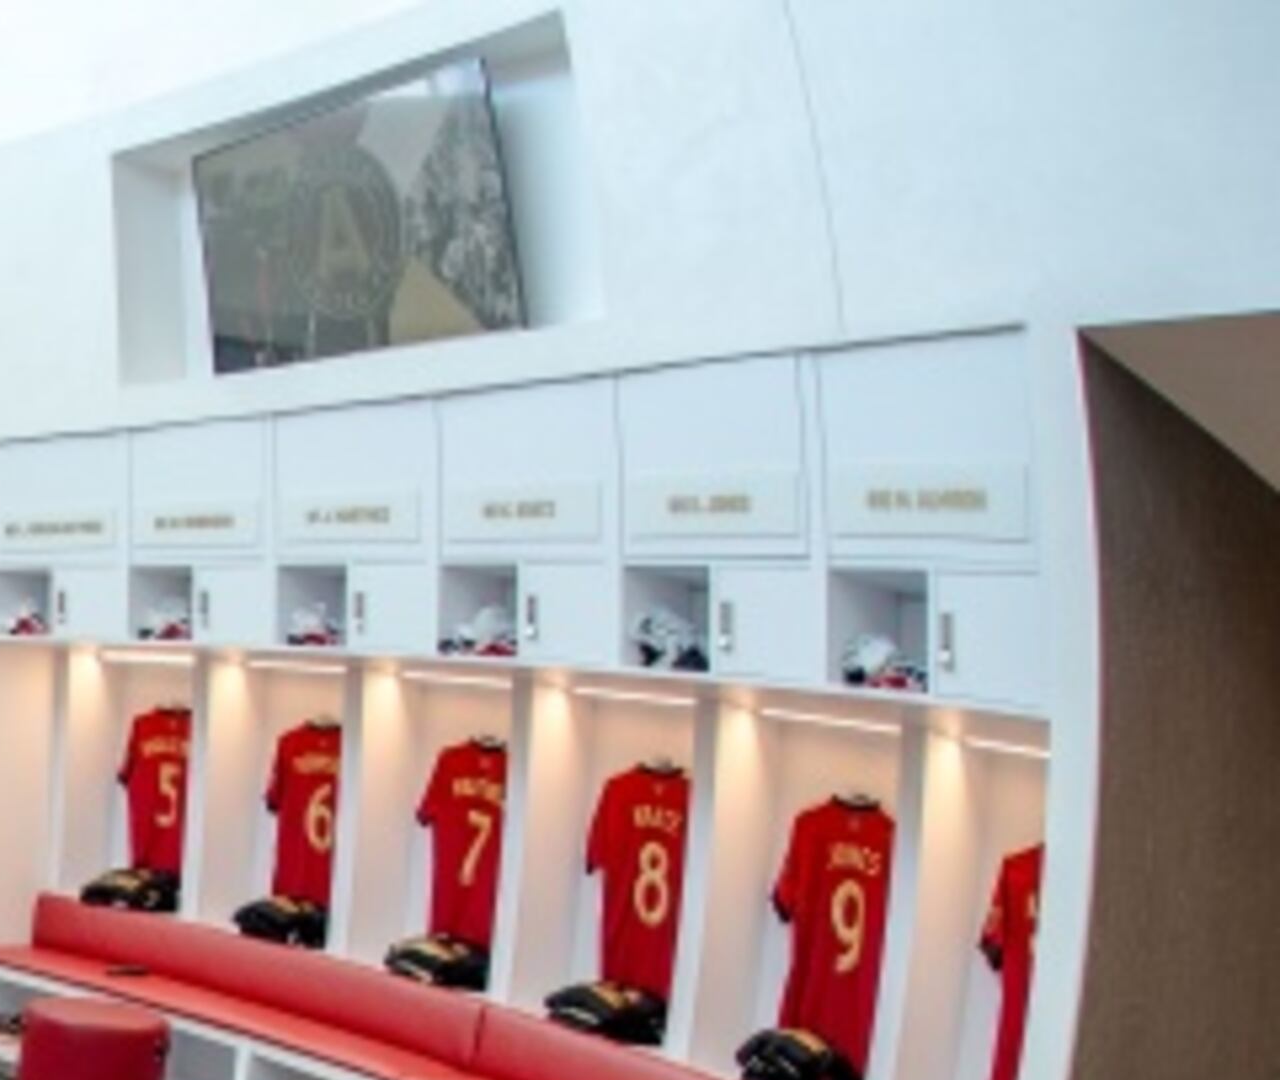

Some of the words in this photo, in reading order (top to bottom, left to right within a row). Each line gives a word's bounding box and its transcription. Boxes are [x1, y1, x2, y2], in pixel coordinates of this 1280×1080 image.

[154, 763, 184, 828] 5
[306, 783, 334, 853] 6
[459, 808, 493, 887] 7
[633, 840, 669, 927] 8
[830, 878, 866, 974] 9
